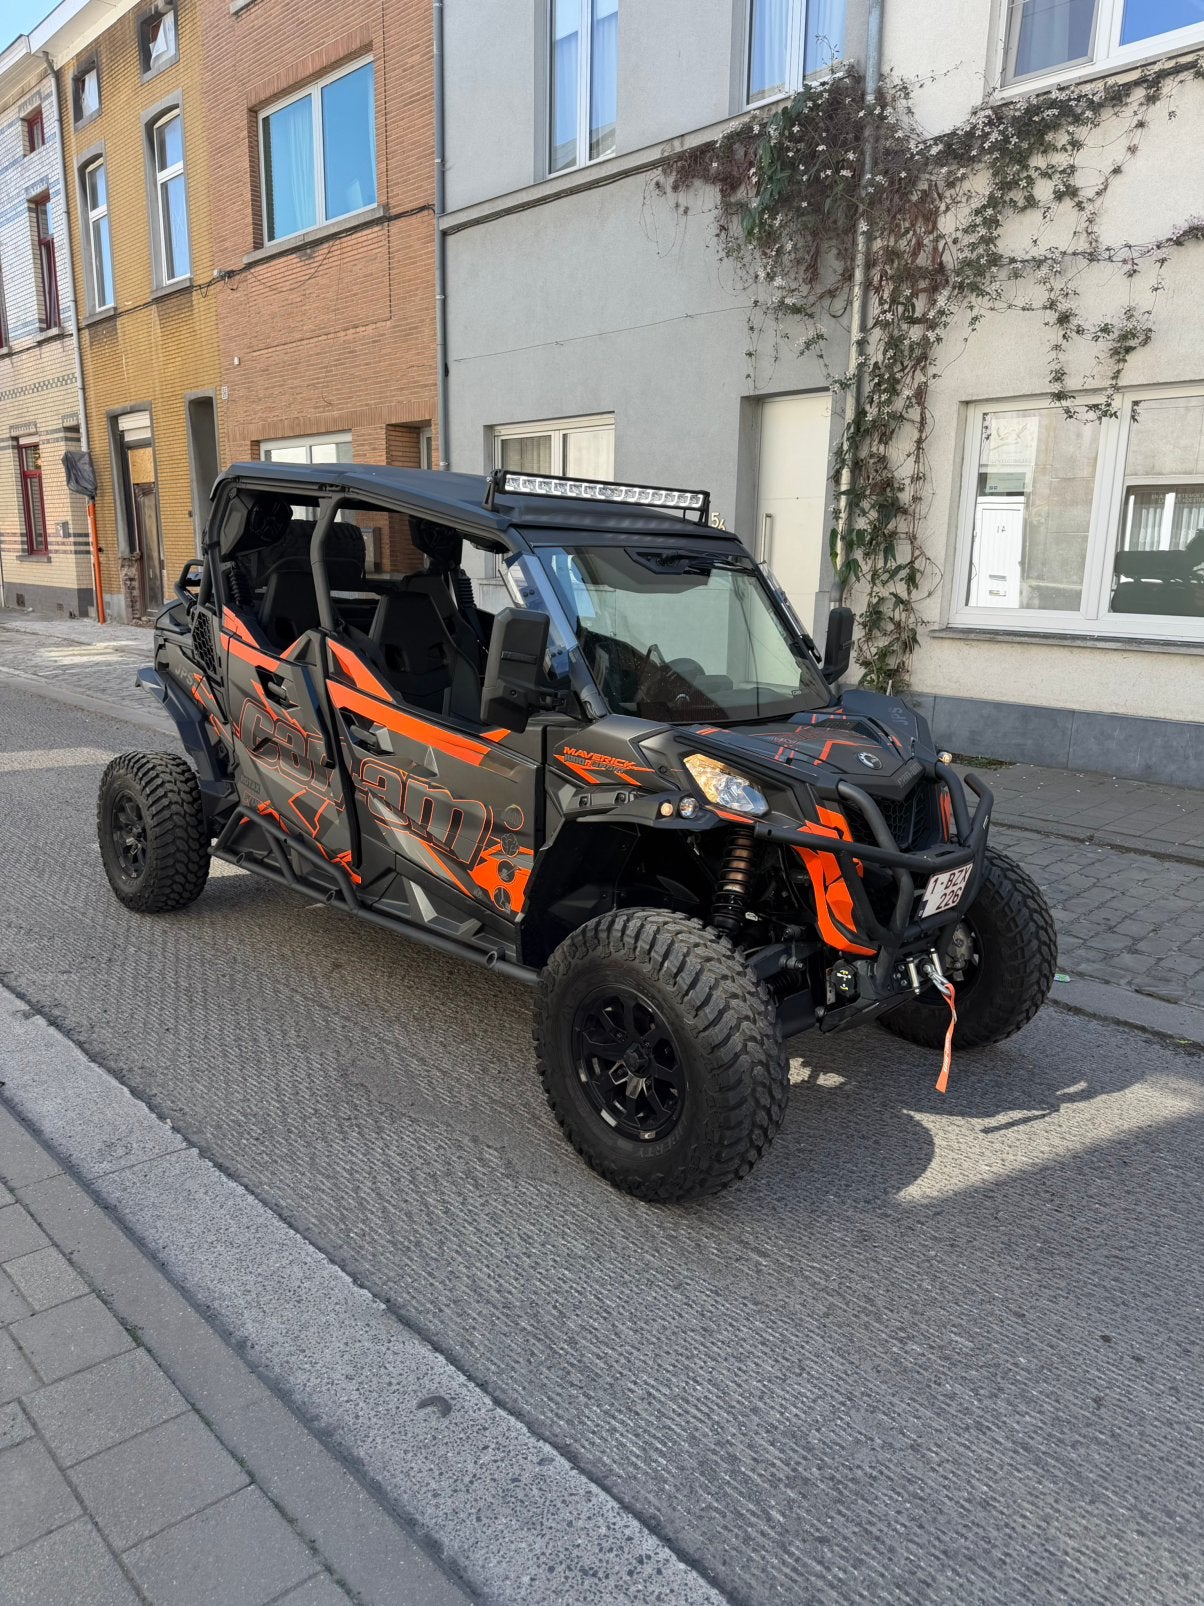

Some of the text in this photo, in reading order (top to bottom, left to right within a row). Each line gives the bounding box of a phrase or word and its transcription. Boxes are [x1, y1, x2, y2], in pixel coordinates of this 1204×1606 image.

[564, 747, 636, 768] MAVERICK
[897, 763, 922, 786] can-am
[931, 866, 970, 895] 1-BZX
[936, 887, 961, 911] 226
